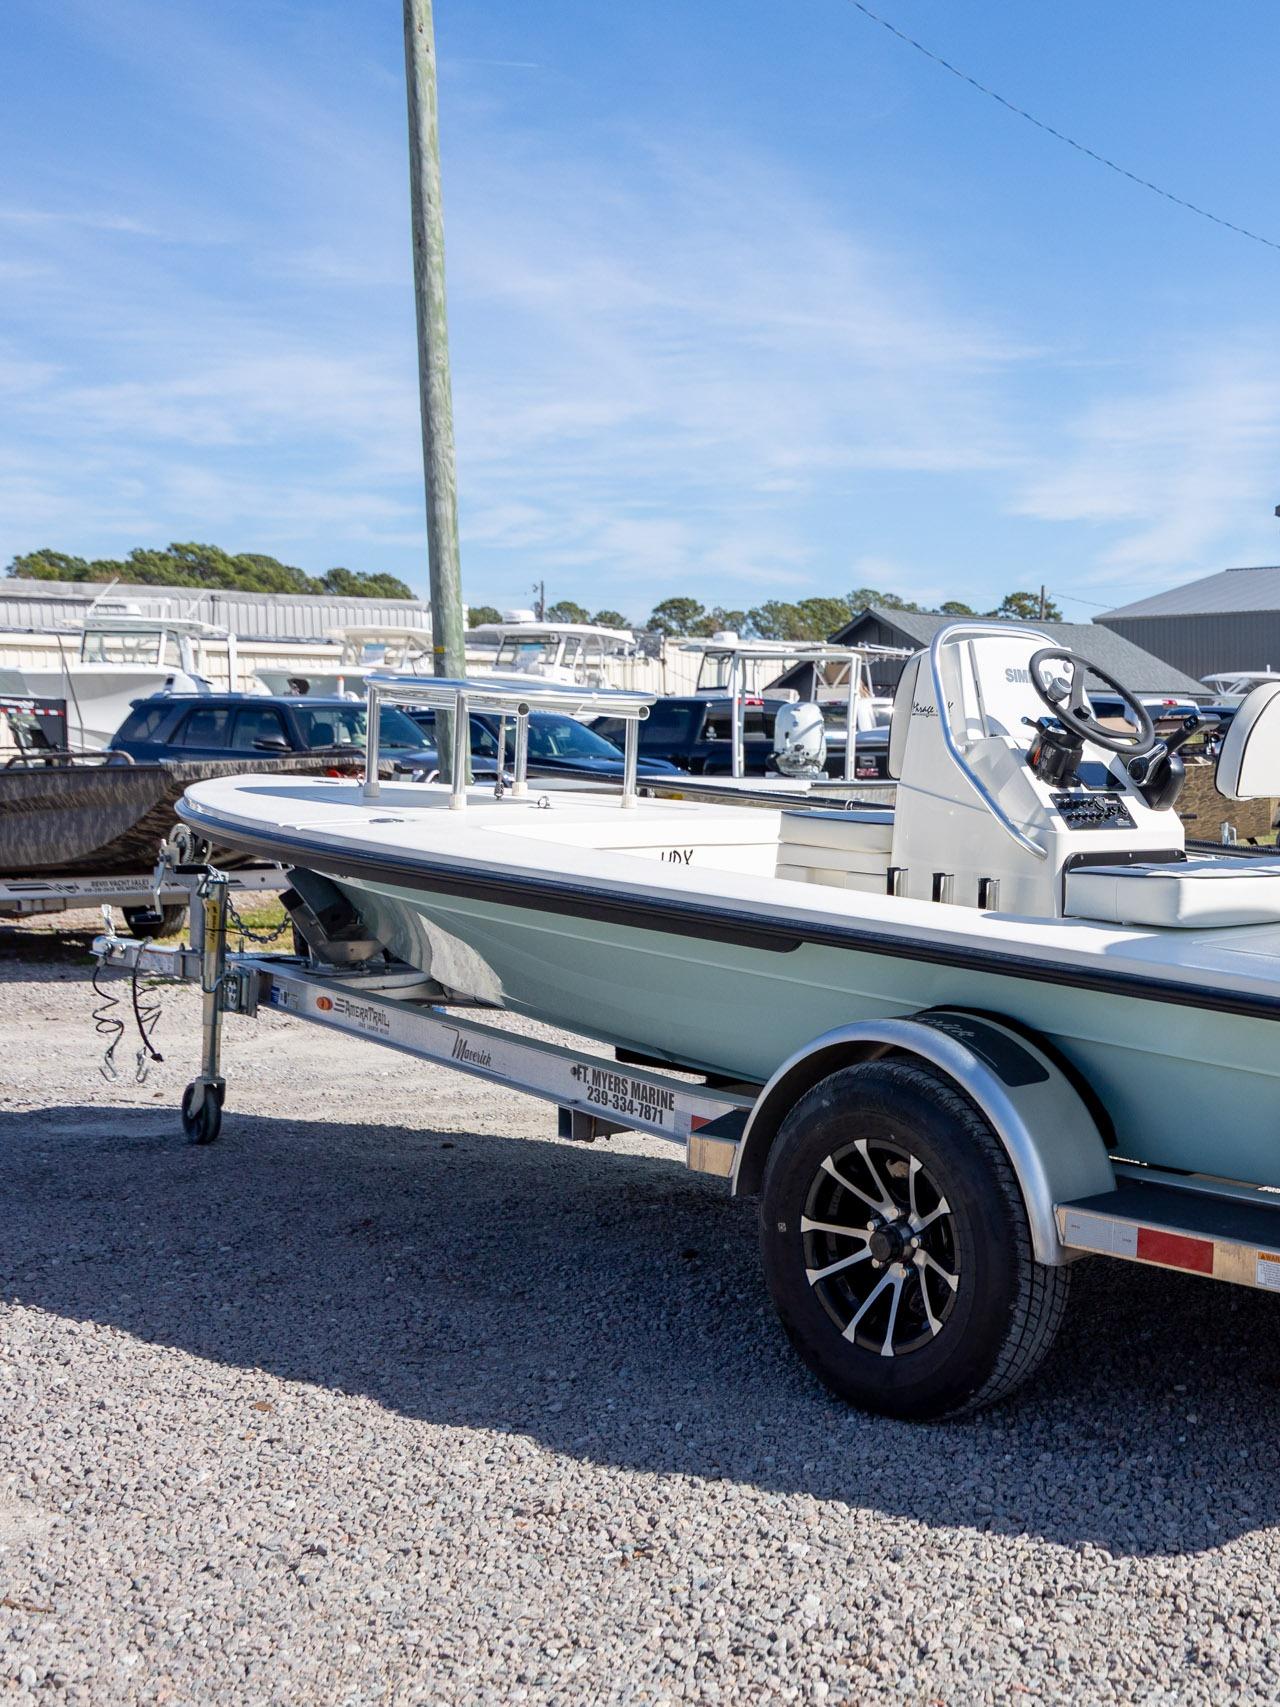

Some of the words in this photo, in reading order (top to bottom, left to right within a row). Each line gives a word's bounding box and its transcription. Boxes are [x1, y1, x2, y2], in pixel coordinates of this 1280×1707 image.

[1005, 668, 1054, 686] SIMD
[443, 1026, 492, 1067] Maverick
[576, 1063, 590, 1084] FT.
[592, 1067, 628, 1097] MYERS
[631, 1081, 675, 1111] MARINE
[587, 1086, 664, 1125] 239-334-7871
